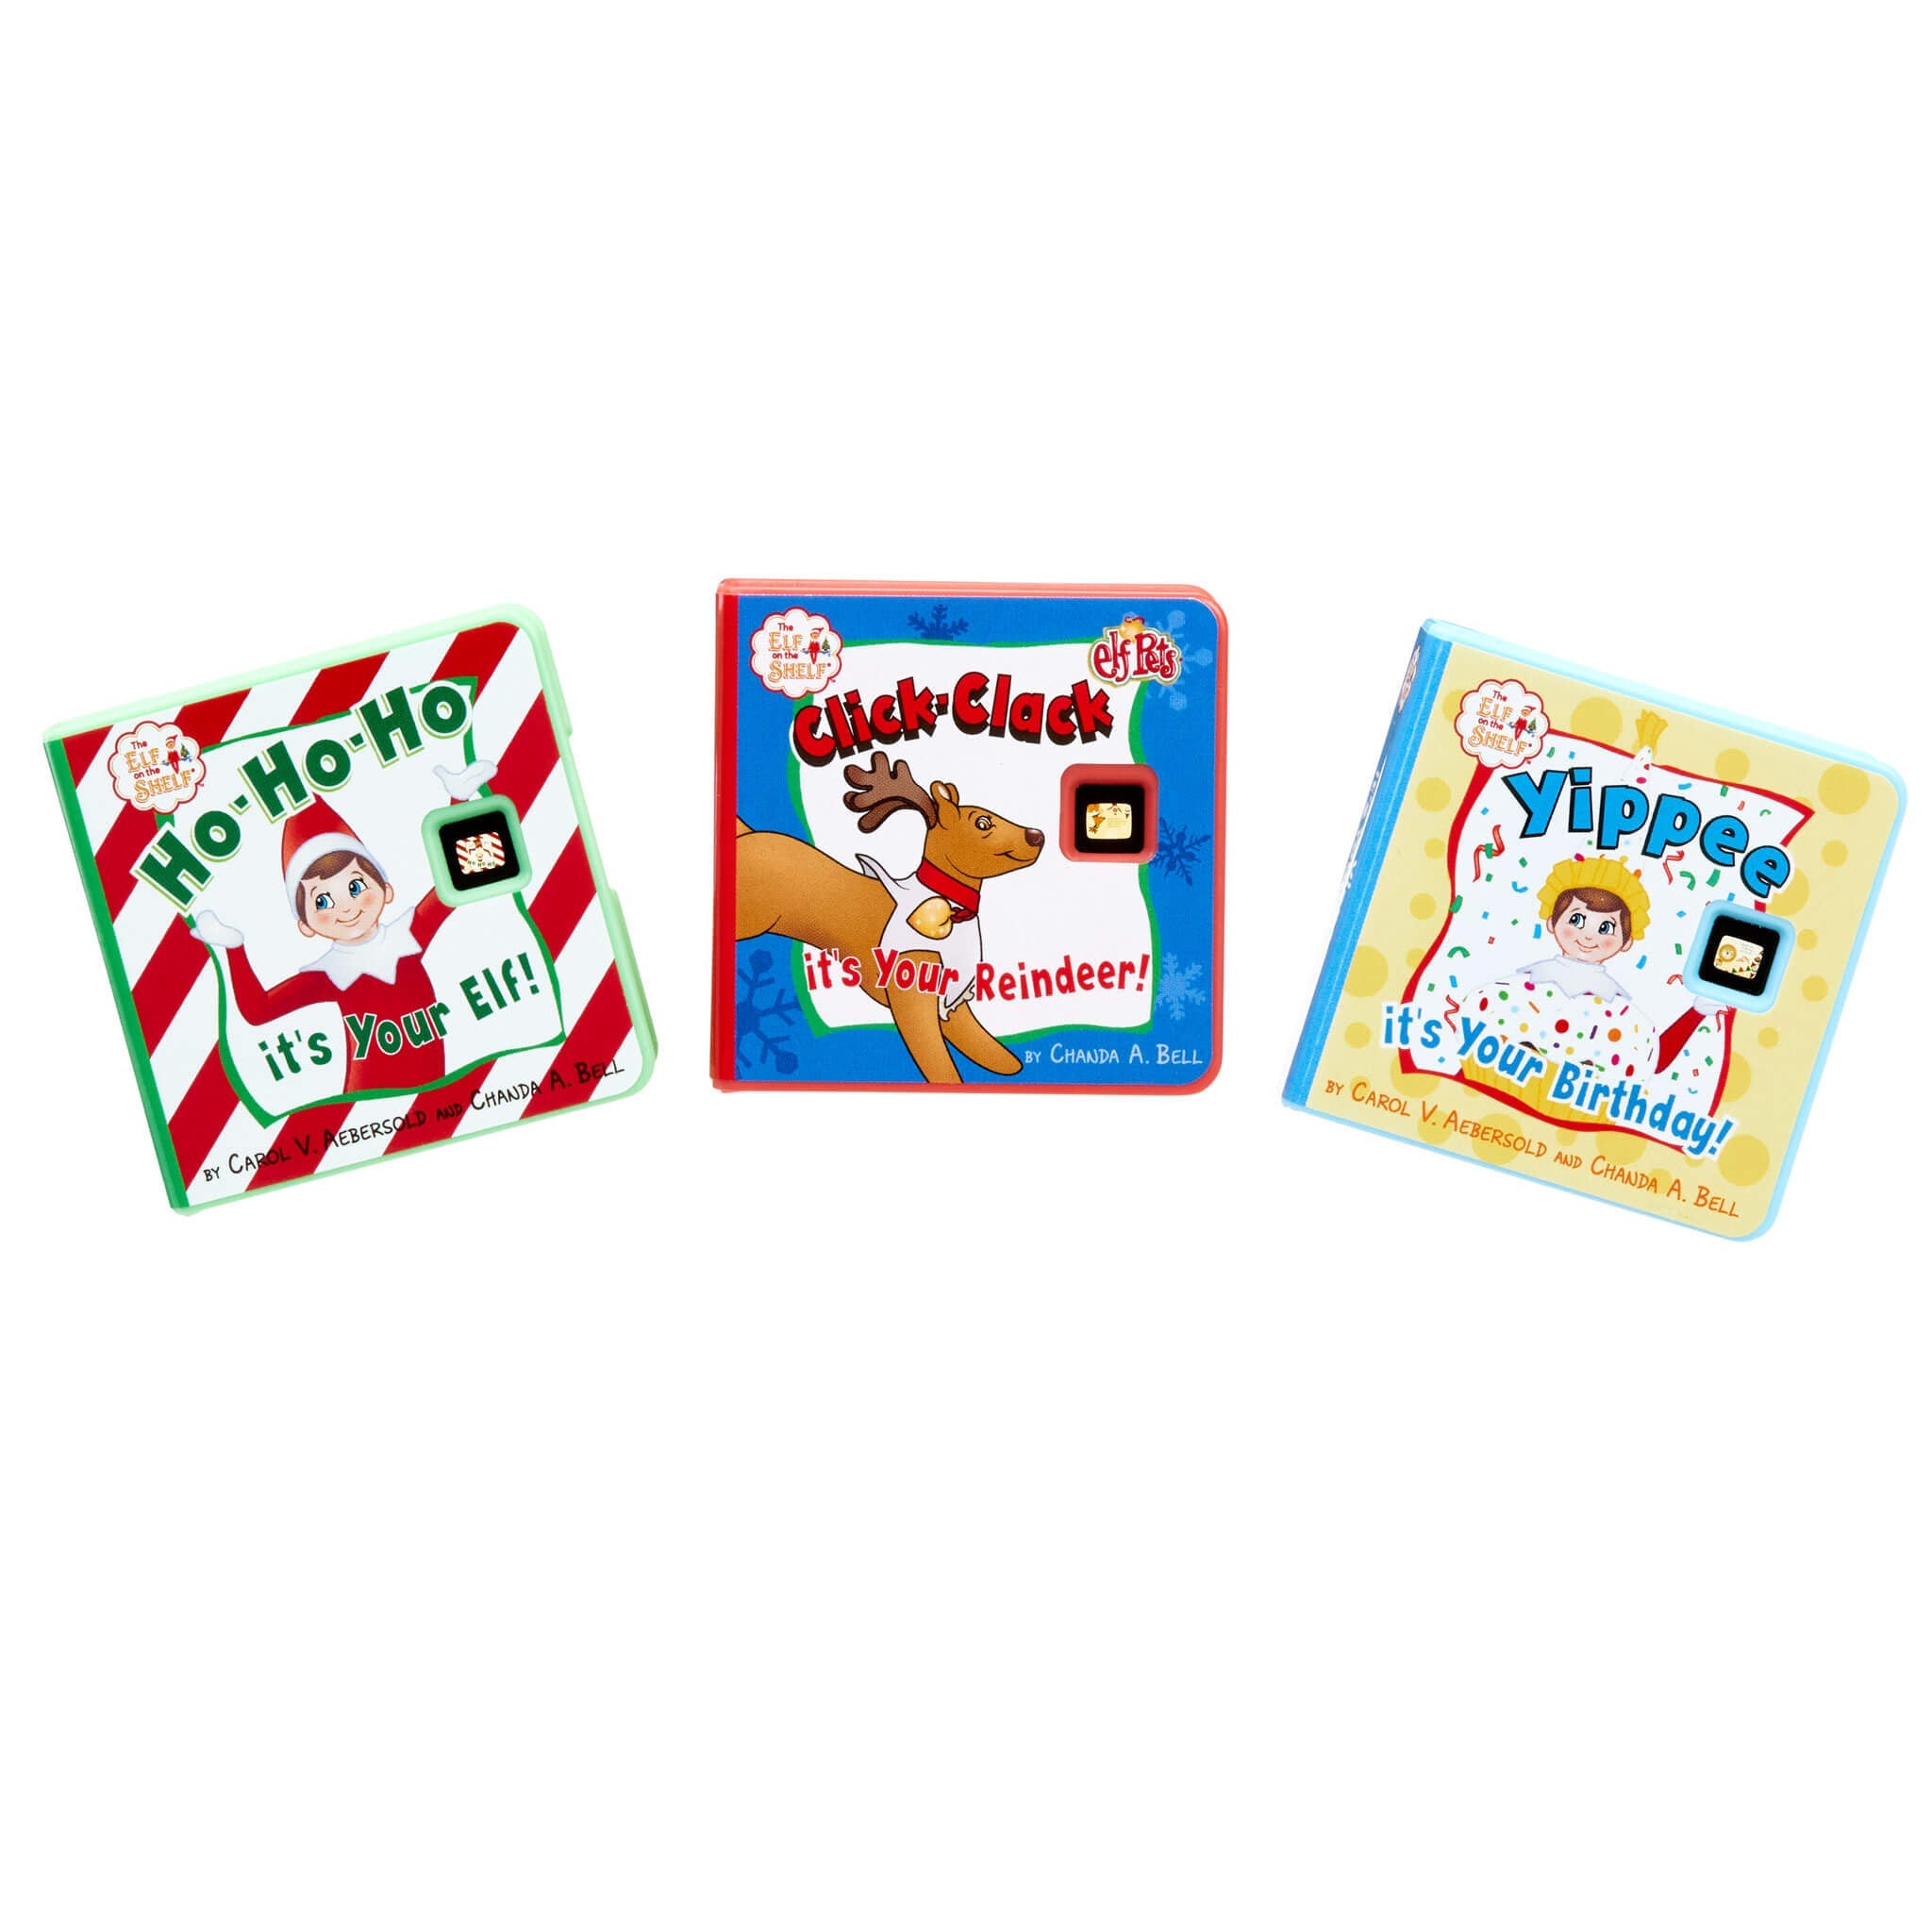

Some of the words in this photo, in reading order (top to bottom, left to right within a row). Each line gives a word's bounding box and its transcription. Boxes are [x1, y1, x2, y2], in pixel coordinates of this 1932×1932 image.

[777, 623, 793, 631] The
[769, 631, 803, 651] ELF
[784, 650, 799, 659] the
[1093, 631, 1131, 682] elf
[1133, 633, 1176, 678] Pets
[1492, 691, 1507, 702] The
[793, 672, 1114, 767] Click-Clack
[1477, 697, 1513, 722] ELF
[1490, 720, 1504, 730] the
[131, 741, 147, 750] The
[125, 748, 158, 773] ELF
[145, 767, 160, 776] the
[136, 686, 467, 911] Ho-Ho-Ho
[1501, 767, 1790, 898] Yippee
[804, 948, 860, 991] it's
[873, 948, 958, 996] Your
[975, 954, 1150, 1002] Reindeer!
[258, 1029, 332, 1081] it's
[344, 1002, 450, 1059] Your
[459, 952, 540, 1021] Elf!
[1024, 1050, 1041, 1063] BY
[1050, 1042, 1120, 1064] CHANDA
[1129, 1043, 1150, 1064] A.
[1156, 1043, 1203, 1064] BELL
[1384, 1006, 1441, 1048] it's
[1457, 1017, 1543, 1082] Your
[1551, 1062, 1734, 1156] Birthday!
[204, 1167, 220, 1181] BY
[228, 1149, 291, 1174] CAROL
[294, 1134, 318, 1156] V.
[324, 1110, 427, 1150] AEBERSOLD
[436, 1103, 463, 1121] AND
[471, 1081, 541, 1110] CHANDA
[550, 1069, 572, 1091] A.
[574, 1059, 625, 1084] BELL
[1324, 1080, 1343, 1095] BY
[1351, 1082, 1410, 1116] CAROL
[1422, 1101, 1438, 1125] V.
[1442, 1109, 1547, 1158] AEBERSOLD
[1554, 1151, 1582, 1169] AND
[1591, 1155, 1658, 1193] CHANDA
[1666, 1178, 1687, 1202] A.
[1693, 1186, 1740, 1218] BELL
